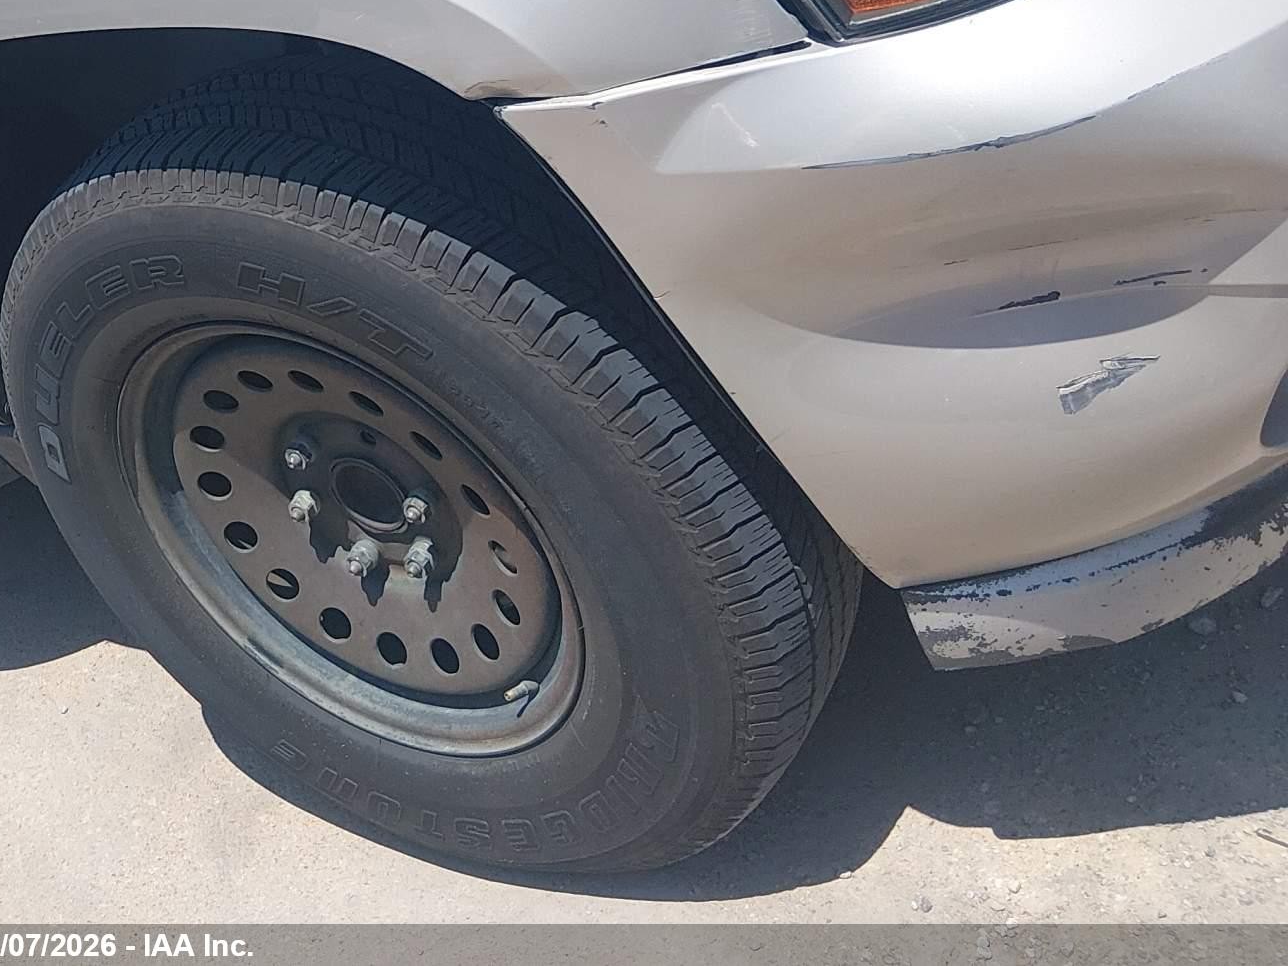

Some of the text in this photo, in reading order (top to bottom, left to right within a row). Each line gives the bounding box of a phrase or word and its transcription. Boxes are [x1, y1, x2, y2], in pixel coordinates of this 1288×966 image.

[34, 254, 434, 484] DUELER H/T
[270, 695, 680, 854] BRIDGESTONE
